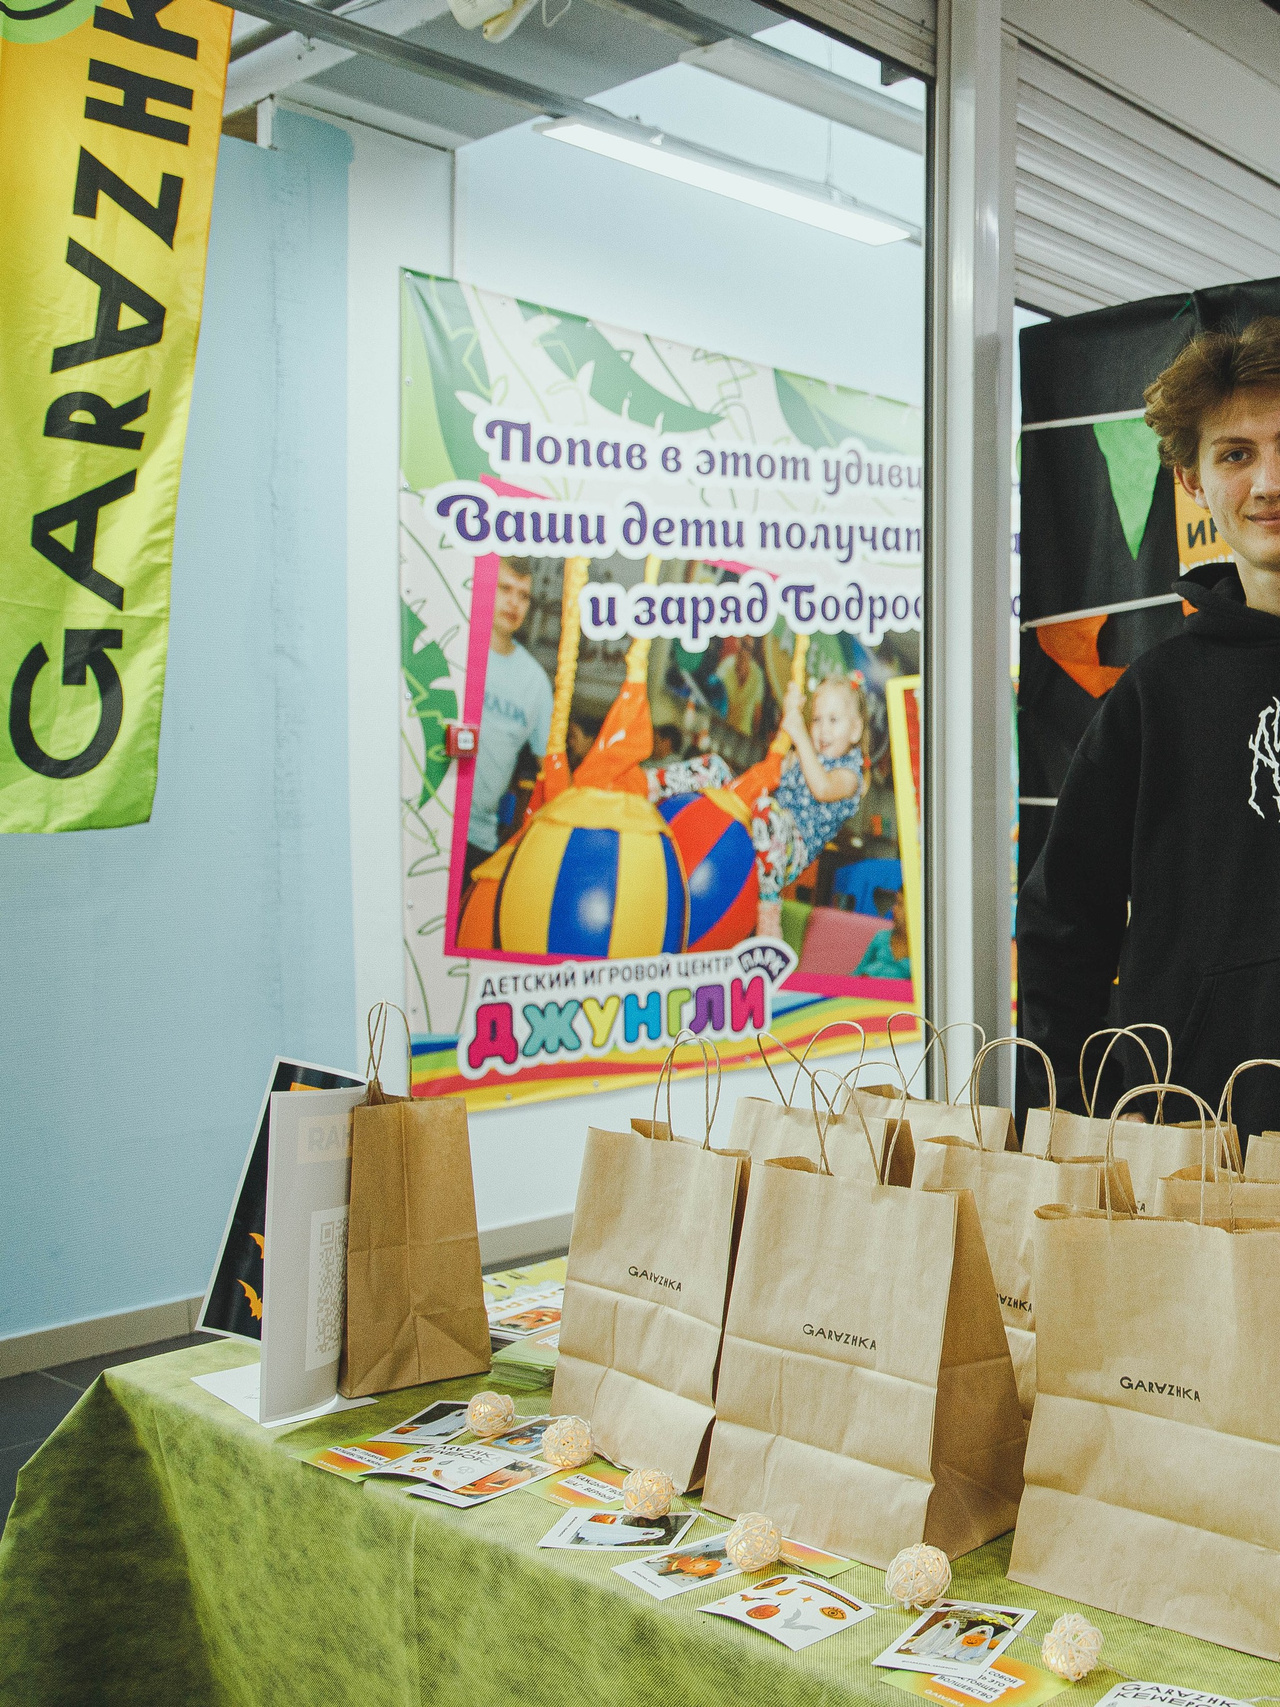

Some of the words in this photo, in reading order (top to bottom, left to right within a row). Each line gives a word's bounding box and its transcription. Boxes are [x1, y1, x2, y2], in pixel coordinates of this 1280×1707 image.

[485, 418, 648, 474] Попав
[661, 444, 683, 475] в
[694, 448, 812, 482] этот
[436, 493, 606, 545] Ваши
[620, 500, 745, 549] дети
[588, 591, 617, 627] и
[632, 580, 769, 639] заряд
[481, 968, 576, 999] ДЕТСКИЙ
[583, 957, 671, 986] ИГРОВОЙ
[676, 956, 734, 979] ЦЕНТР
[738, 946, 786, 978] ПАРК
[467, 975, 766, 1069] ДЖУНГЛИ
